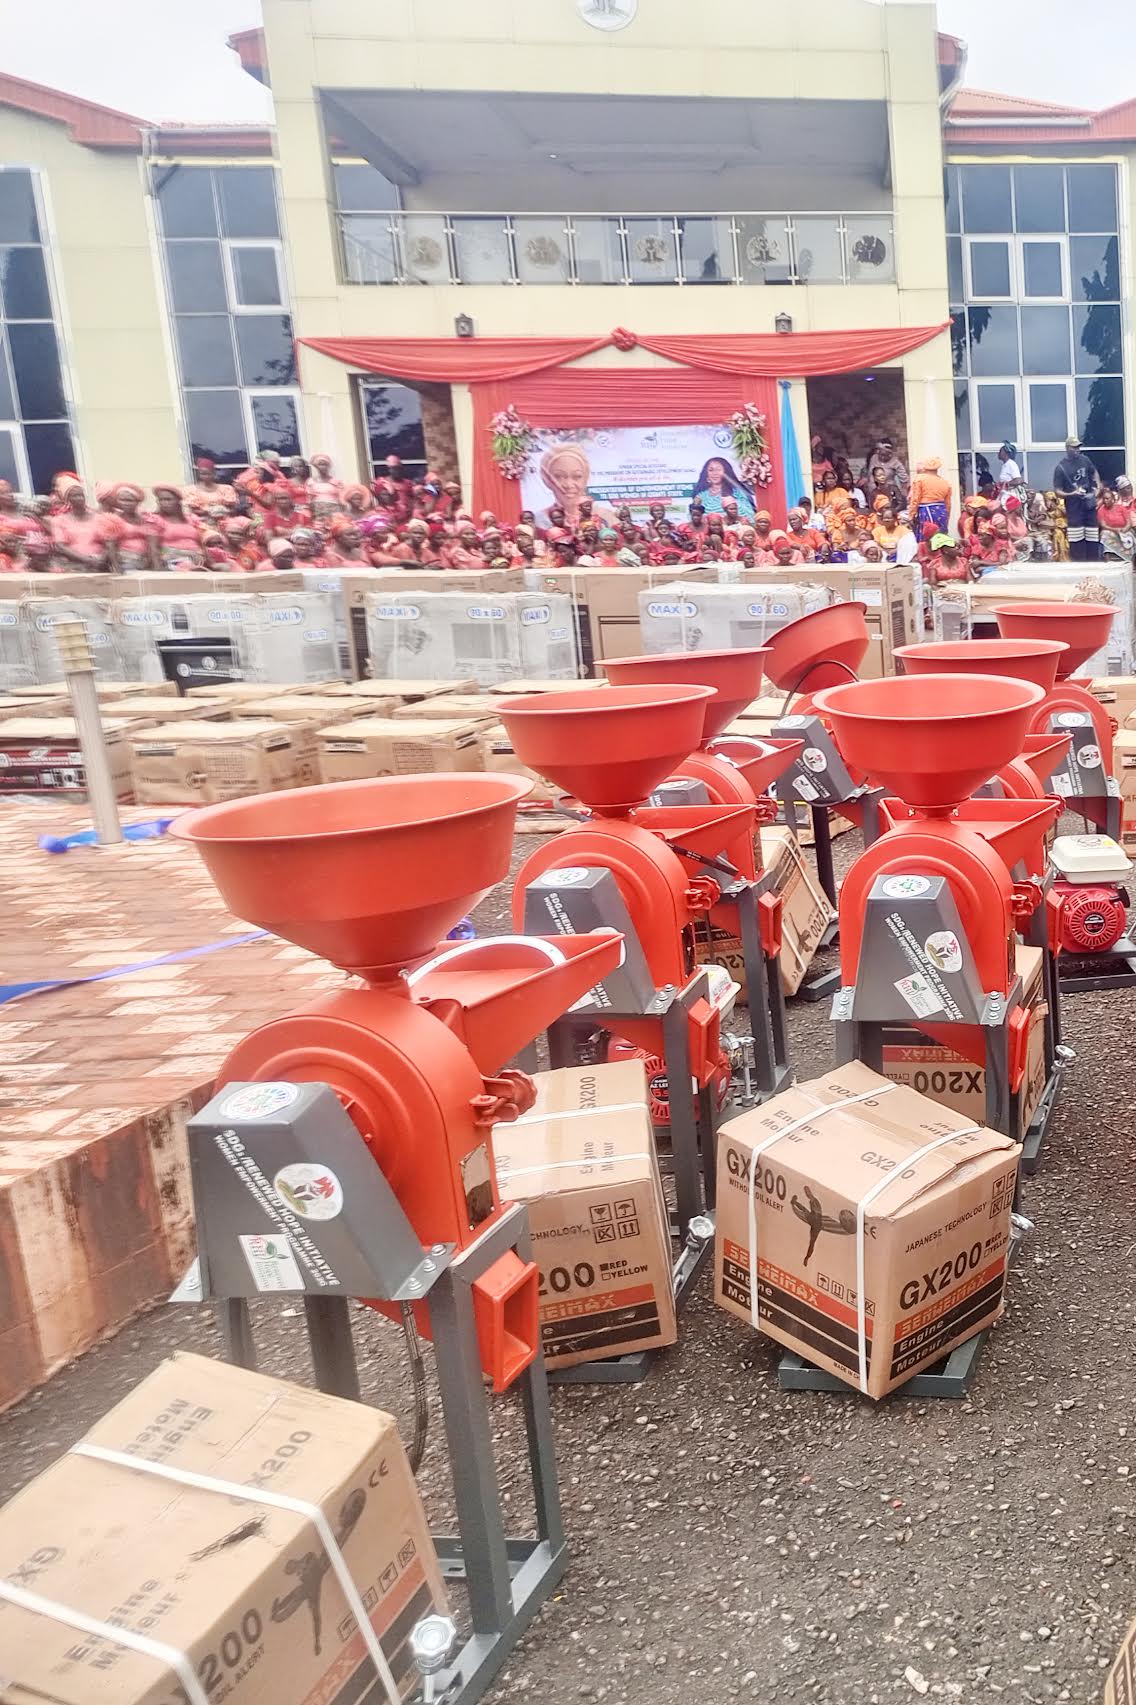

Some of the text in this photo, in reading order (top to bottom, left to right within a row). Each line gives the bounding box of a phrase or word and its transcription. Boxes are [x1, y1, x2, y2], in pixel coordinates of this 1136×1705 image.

[925, 962, 942, 984] HOPE
[914, 1070, 983, 1094] X200
[860, 1150, 916, 1180] GX20
[213, 1134, 240, 1167] WOMEN
[234, 1165, 283, 1223] EMPOWERMENT
[277, 1222, 317, 1268] PROGRAMME
[765, 1197, 784, 1214] ALERT
[905, 1202, 988, 1254] JAPANESE TECHNOLOGY
[278, 1203, 306, 1236] HOPE
[299, 1235, 341, 1287] INITIATIVE
[609, 1259, 628, 1270] RED
[611, 1264, 649, 1280] YELLOW
[900, 1241, 983, 1311] GX200
[899, 1318, 945, 1351] Engine
[896, 1338, 942, 1373] Moteur
